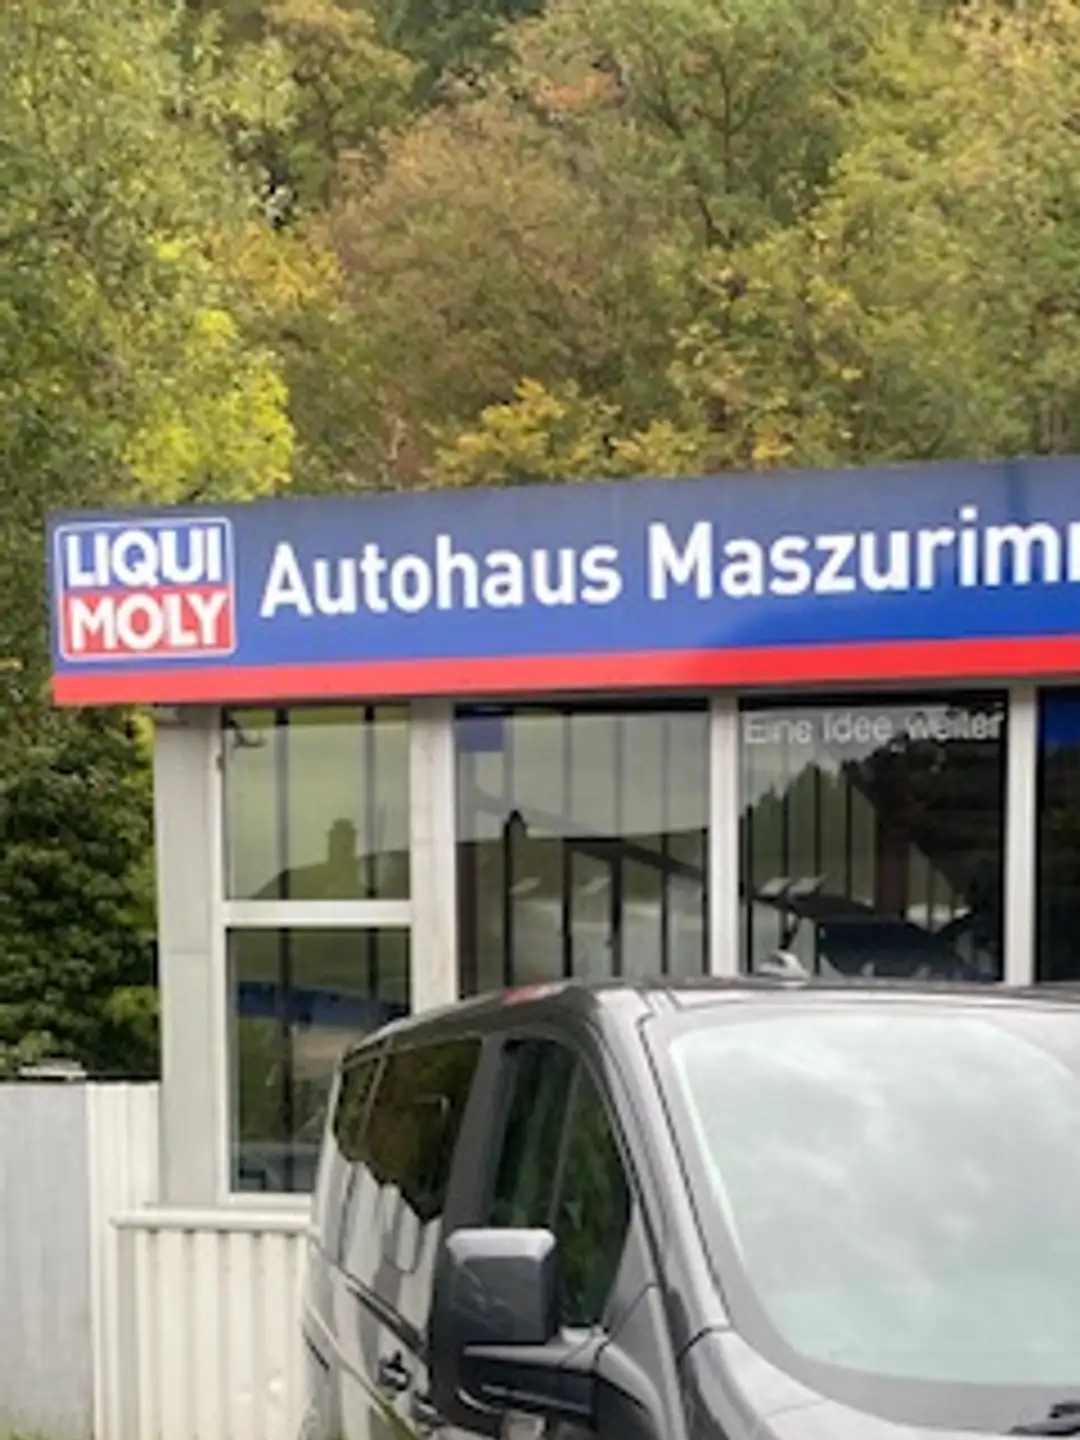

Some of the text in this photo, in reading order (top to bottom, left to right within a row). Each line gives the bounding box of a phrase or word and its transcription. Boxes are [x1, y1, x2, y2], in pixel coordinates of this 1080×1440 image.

[66, 526, 222, 588] LIQUI
[260, 535, 622, 617] Autohaus
[69, 592, 228, 651] MOLY
